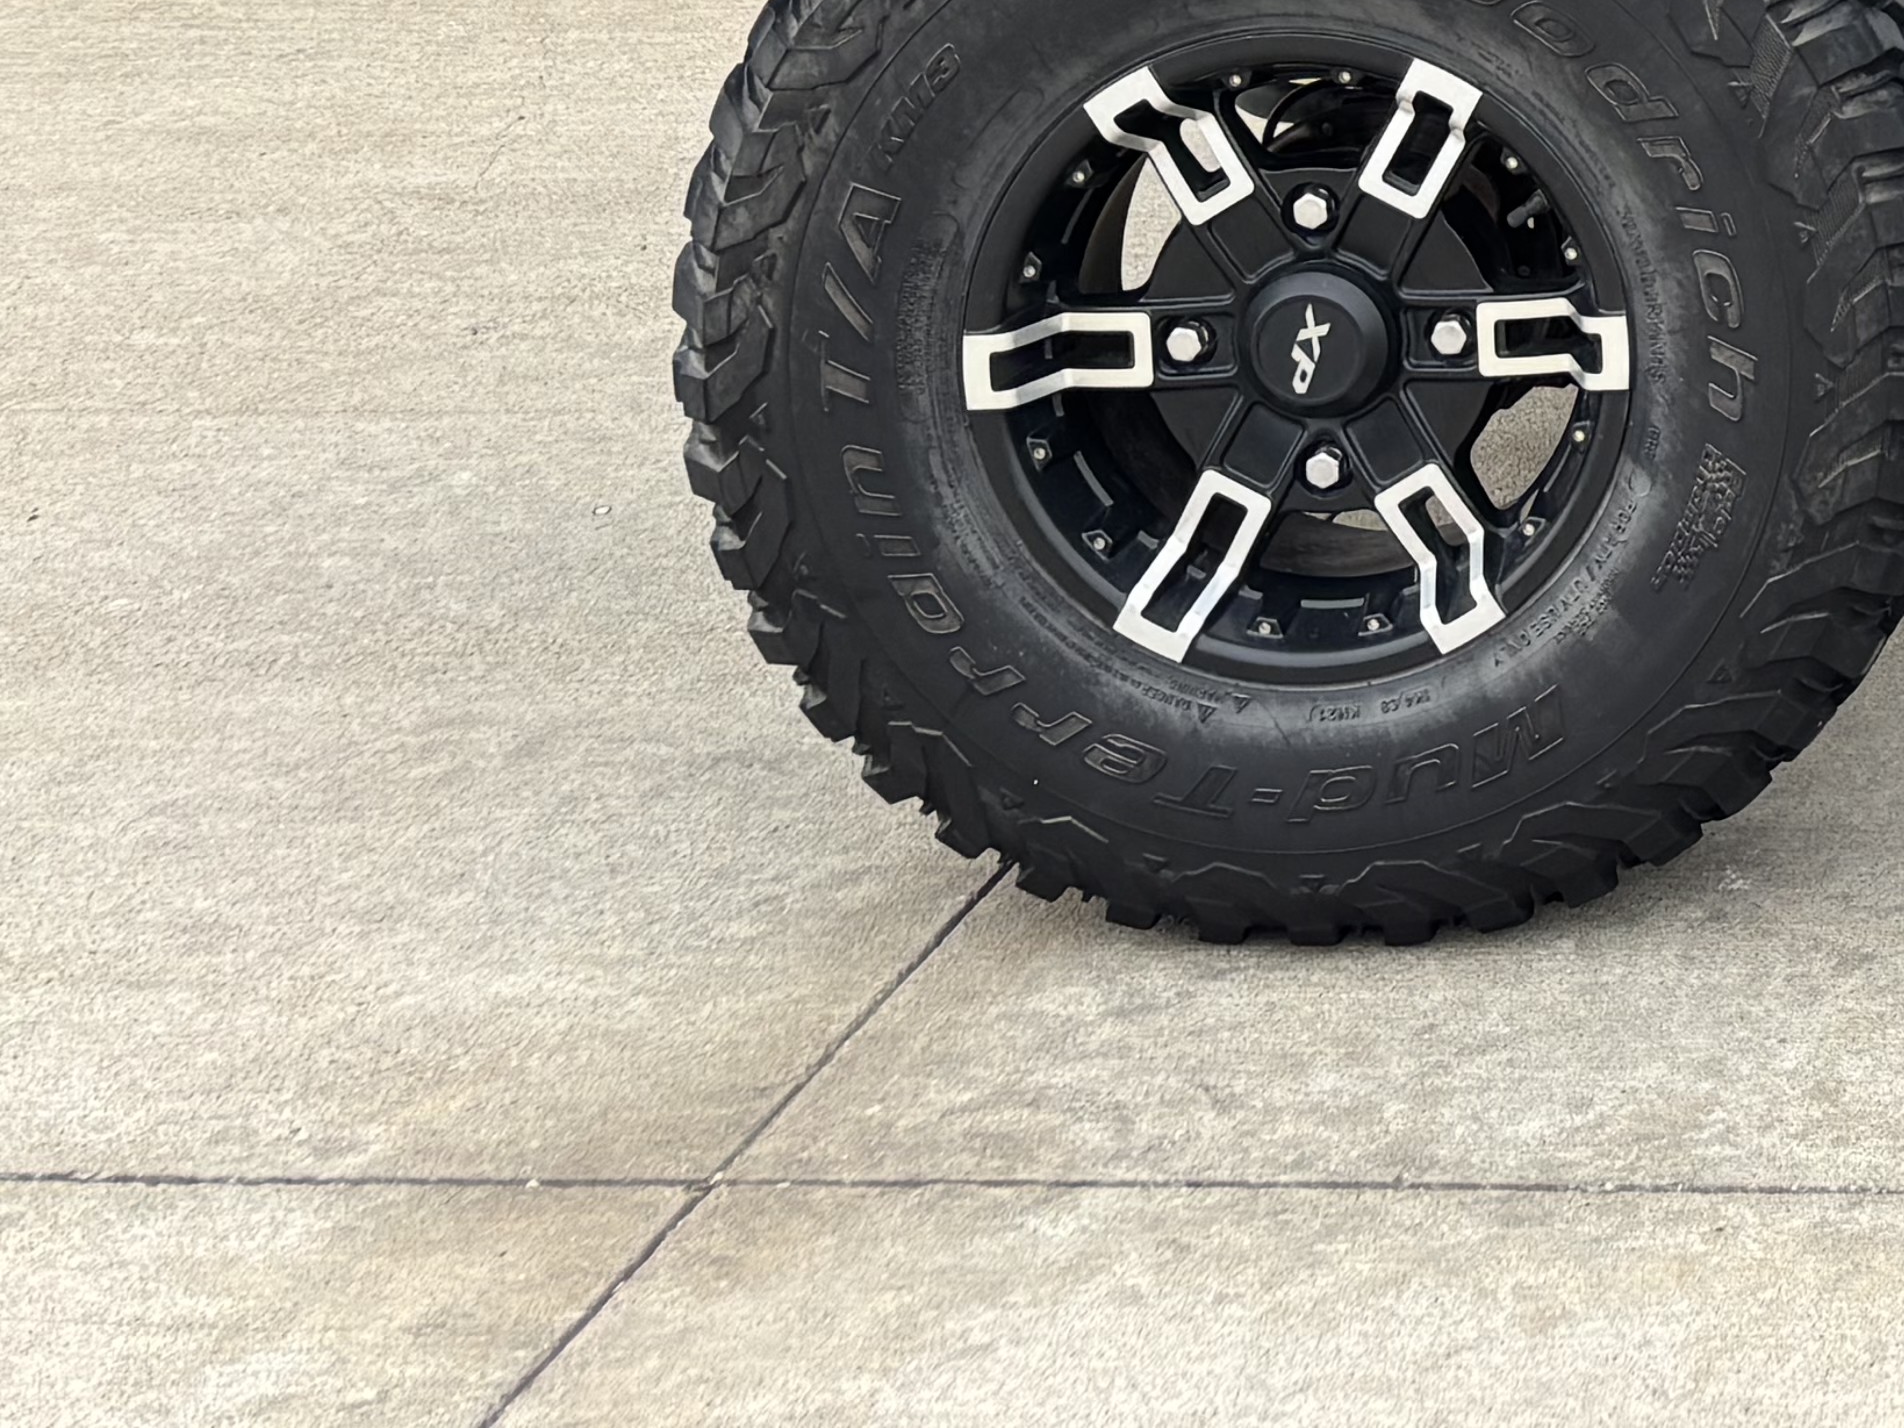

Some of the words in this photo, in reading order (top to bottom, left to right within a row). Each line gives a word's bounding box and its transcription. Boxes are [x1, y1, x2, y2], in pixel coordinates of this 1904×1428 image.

[820, 180, 900, 417] T/A
[1290, 303, 1332, 395] XP
[856, 446, 1567, 825] Mud-Terrain
